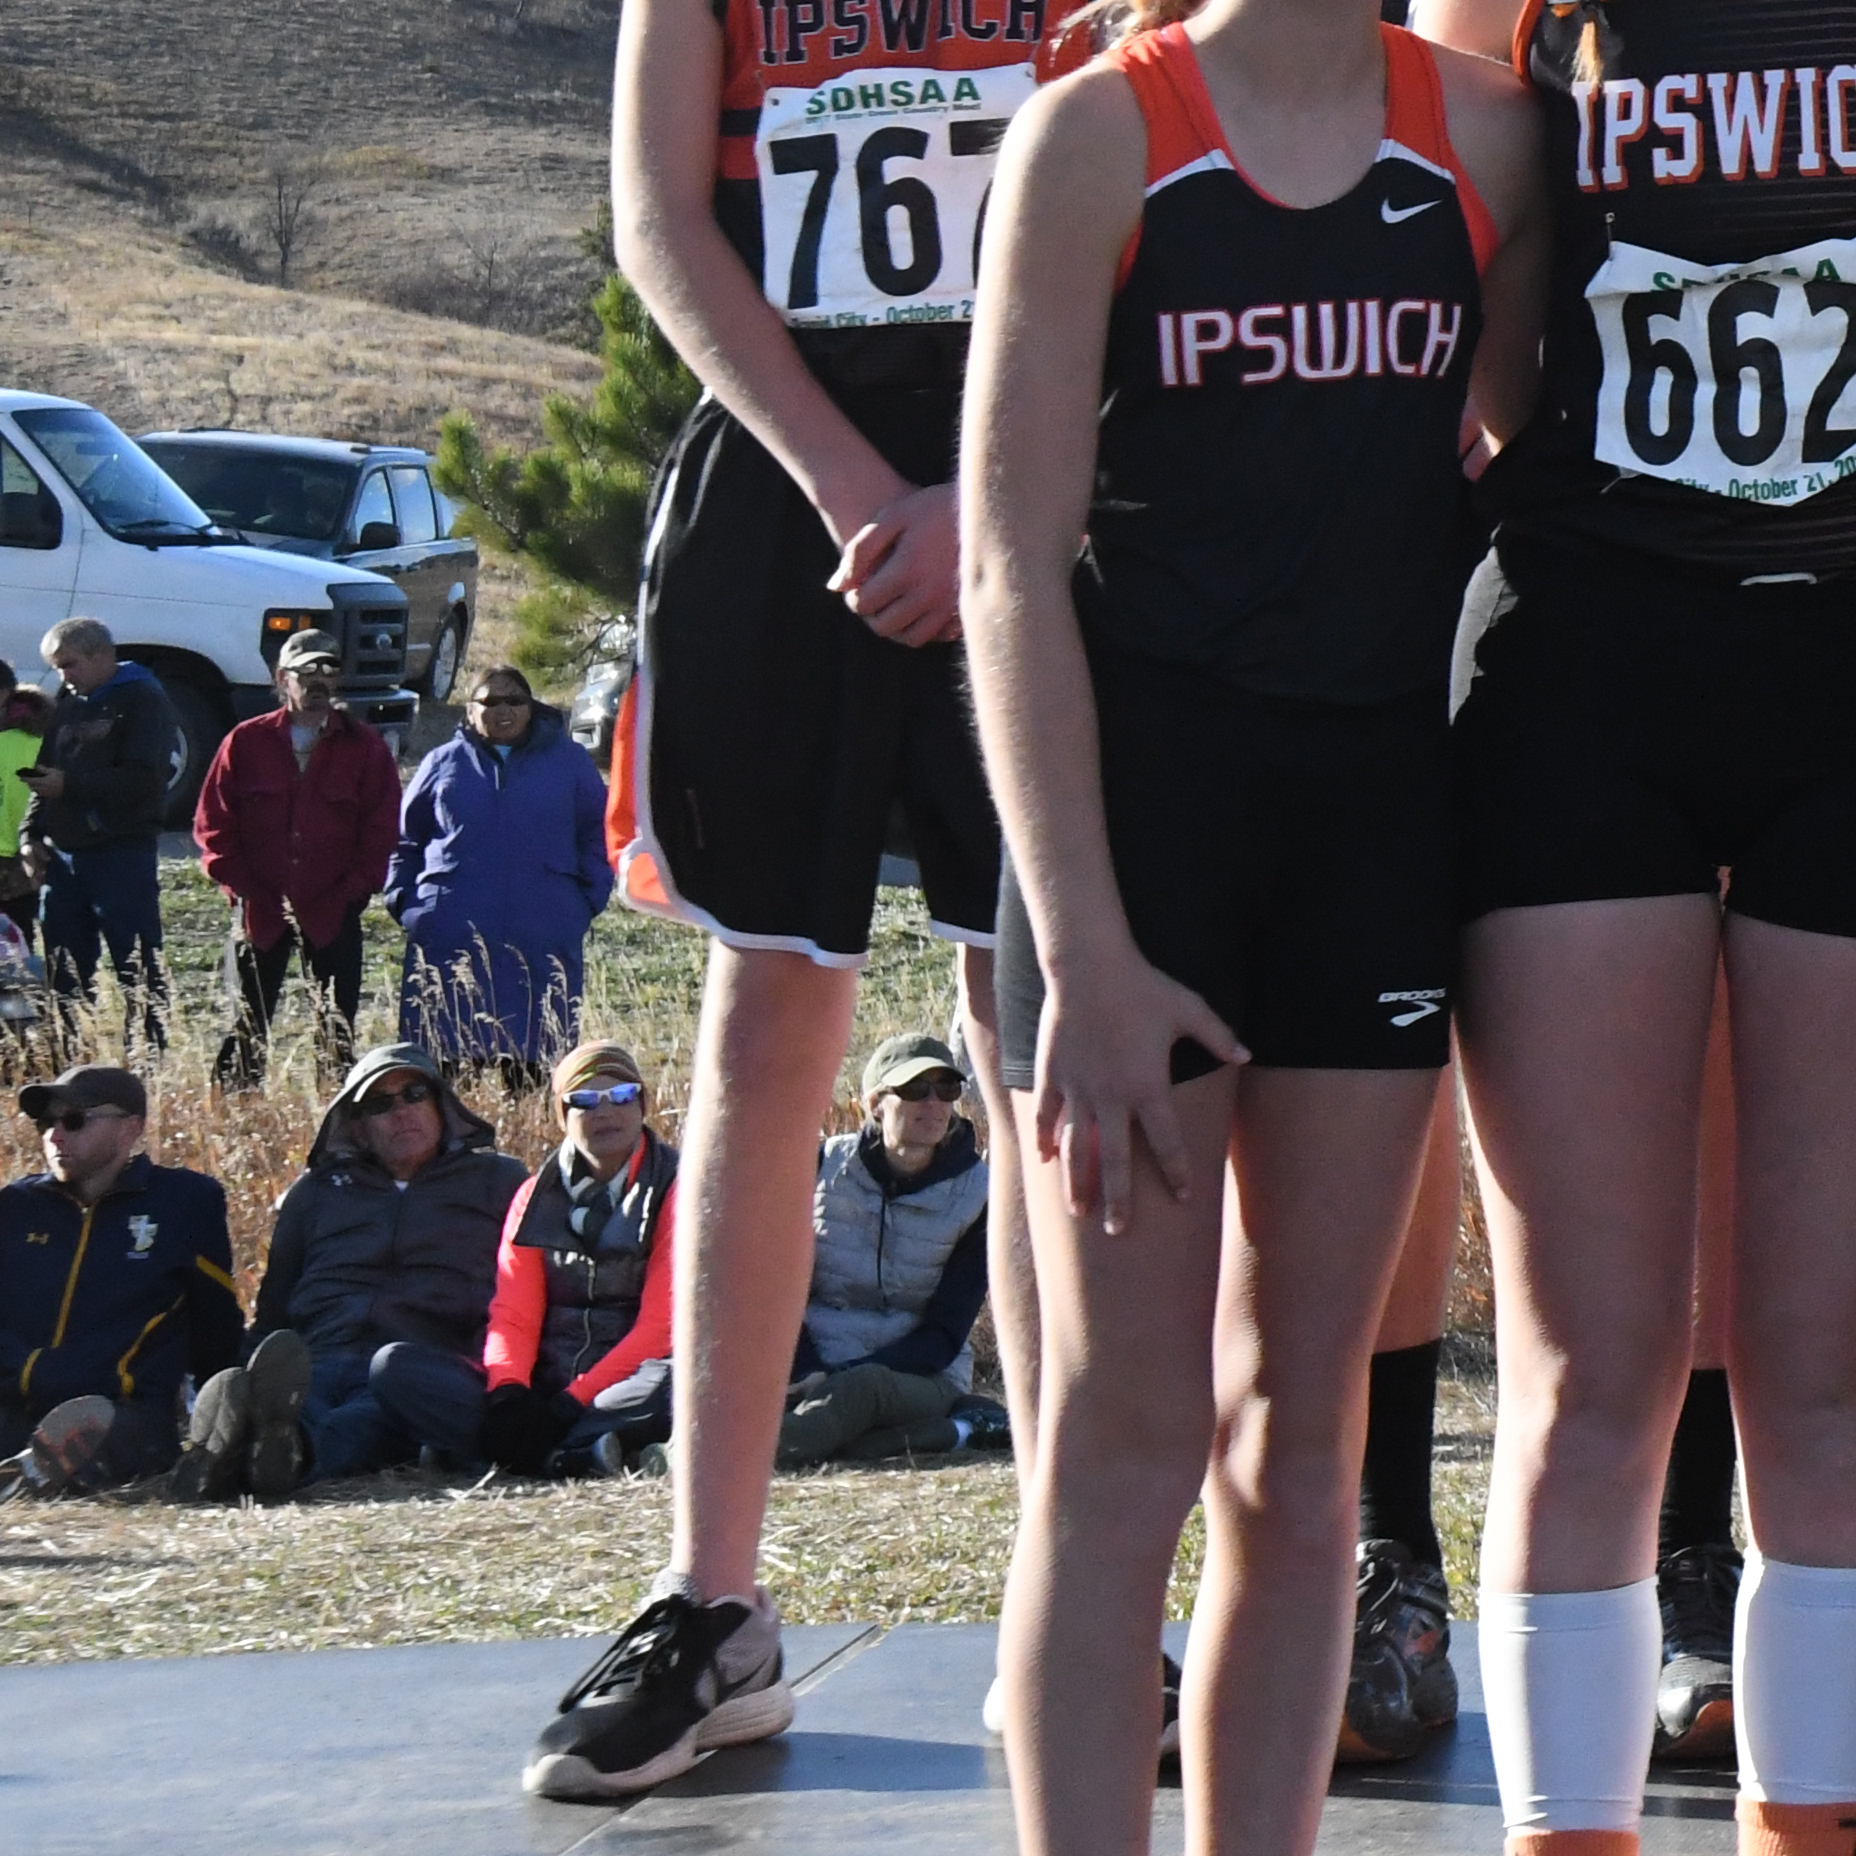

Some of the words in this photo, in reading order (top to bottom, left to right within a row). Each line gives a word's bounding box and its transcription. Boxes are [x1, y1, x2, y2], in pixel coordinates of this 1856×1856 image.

[805, 77, 982, 115] SDHSAA
[887, 303, 955, 324] October
[1158, 297, 1463, 388] IPSWICH
[1728, 477, 1798, 501] October
